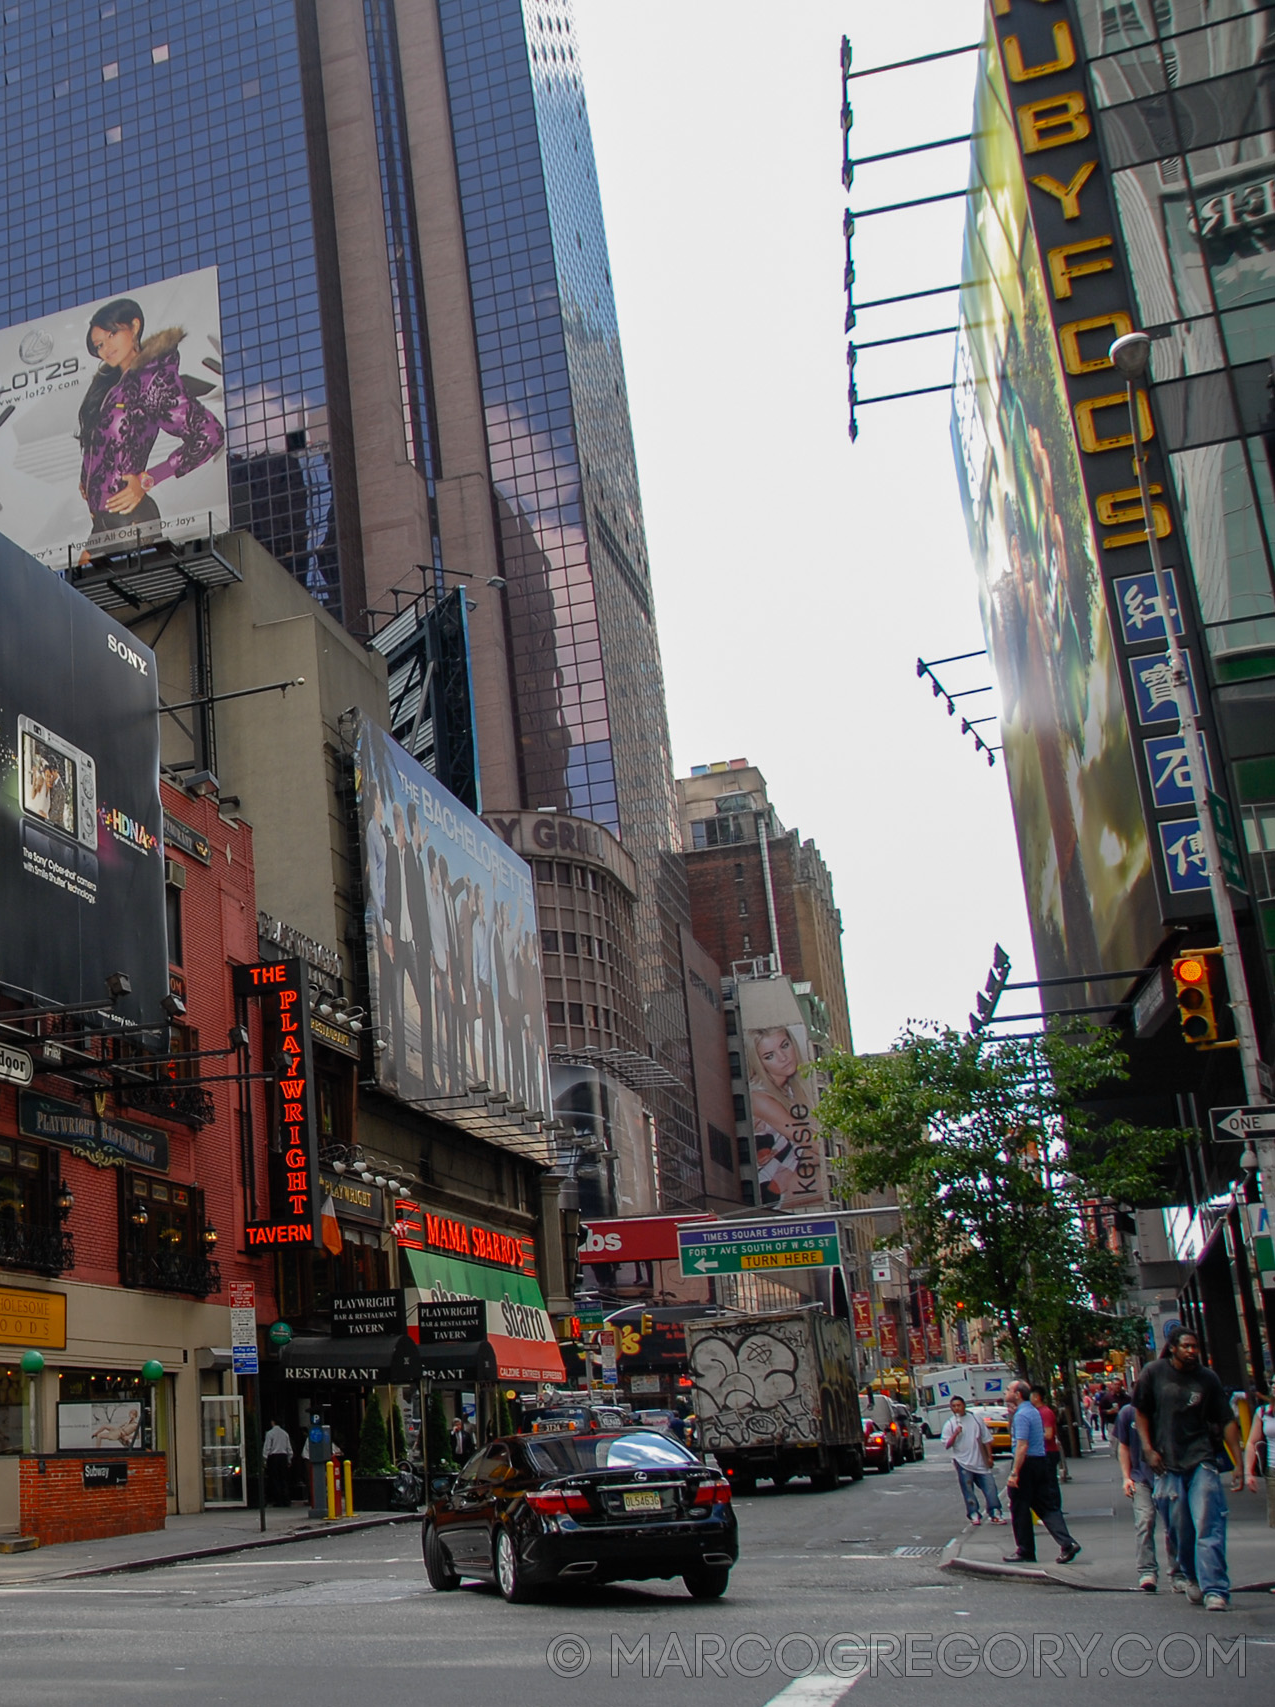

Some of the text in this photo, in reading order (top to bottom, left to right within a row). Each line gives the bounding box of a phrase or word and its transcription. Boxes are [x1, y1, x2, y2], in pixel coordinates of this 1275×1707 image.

[104, 531, 117, 544] All
[159, 518, 174, 530] Dr.
[176, 514, 196, 529] Jays
[108, 633, 148, 676] SONY
[113, 808, 148, 849] HDNA
[398, 770, 532, 907] THE BACHELORETTE
[532, 818, 606, 861] GRILL
[23, 861, 35, 875] with
[34, 865, 49, 881] Smile
[76, 874, 97, 892] camera
[250, 965, 286, 985] THE
[278, 990, 309, 1215] PLAYWRIGHT
[1229, 1116, 1262, 1131] ONE
[35, 1111, 156, 1163] PLAYWRIGHT RESTAURANT
[785, 1103, 818, 1195] kensie
[325, 1183, 372, 1208] PLAYWRIGHT
[246, 1223, 313, 1245] TAVERN
[425, 1212, 524, 1267] MAMA SBARRO'S
[702, 1225, 813, 1242] TIMES SQUARE SHUFFLE
[689, 1238, 830, 1257] FOR 7 AVE SOUTH OF W 45 ST
[746, 1251, 818, 1267] TURN HERE
[333, 1296, 396, 1310] PLAYWRIGHT
[420, 1306, 479, 1319] PLAYWRIGHT
[333, 1313, 348, 1321] BAR
[355, 1310, 398, 1320] RESTAURANT
[440, 1319, 480, 1327] RESTAURANT
[500, 1292, 547, 1343] sbarro
[348, 1323, 385, 1335] TAVERN
[434, 1331, 467, 1341] TAVERN
[284, 1367, 379, 1382] RESTAURANT
[313, 1414, 320, 1424] P
[84, 1464, 110, 1480] Subway
